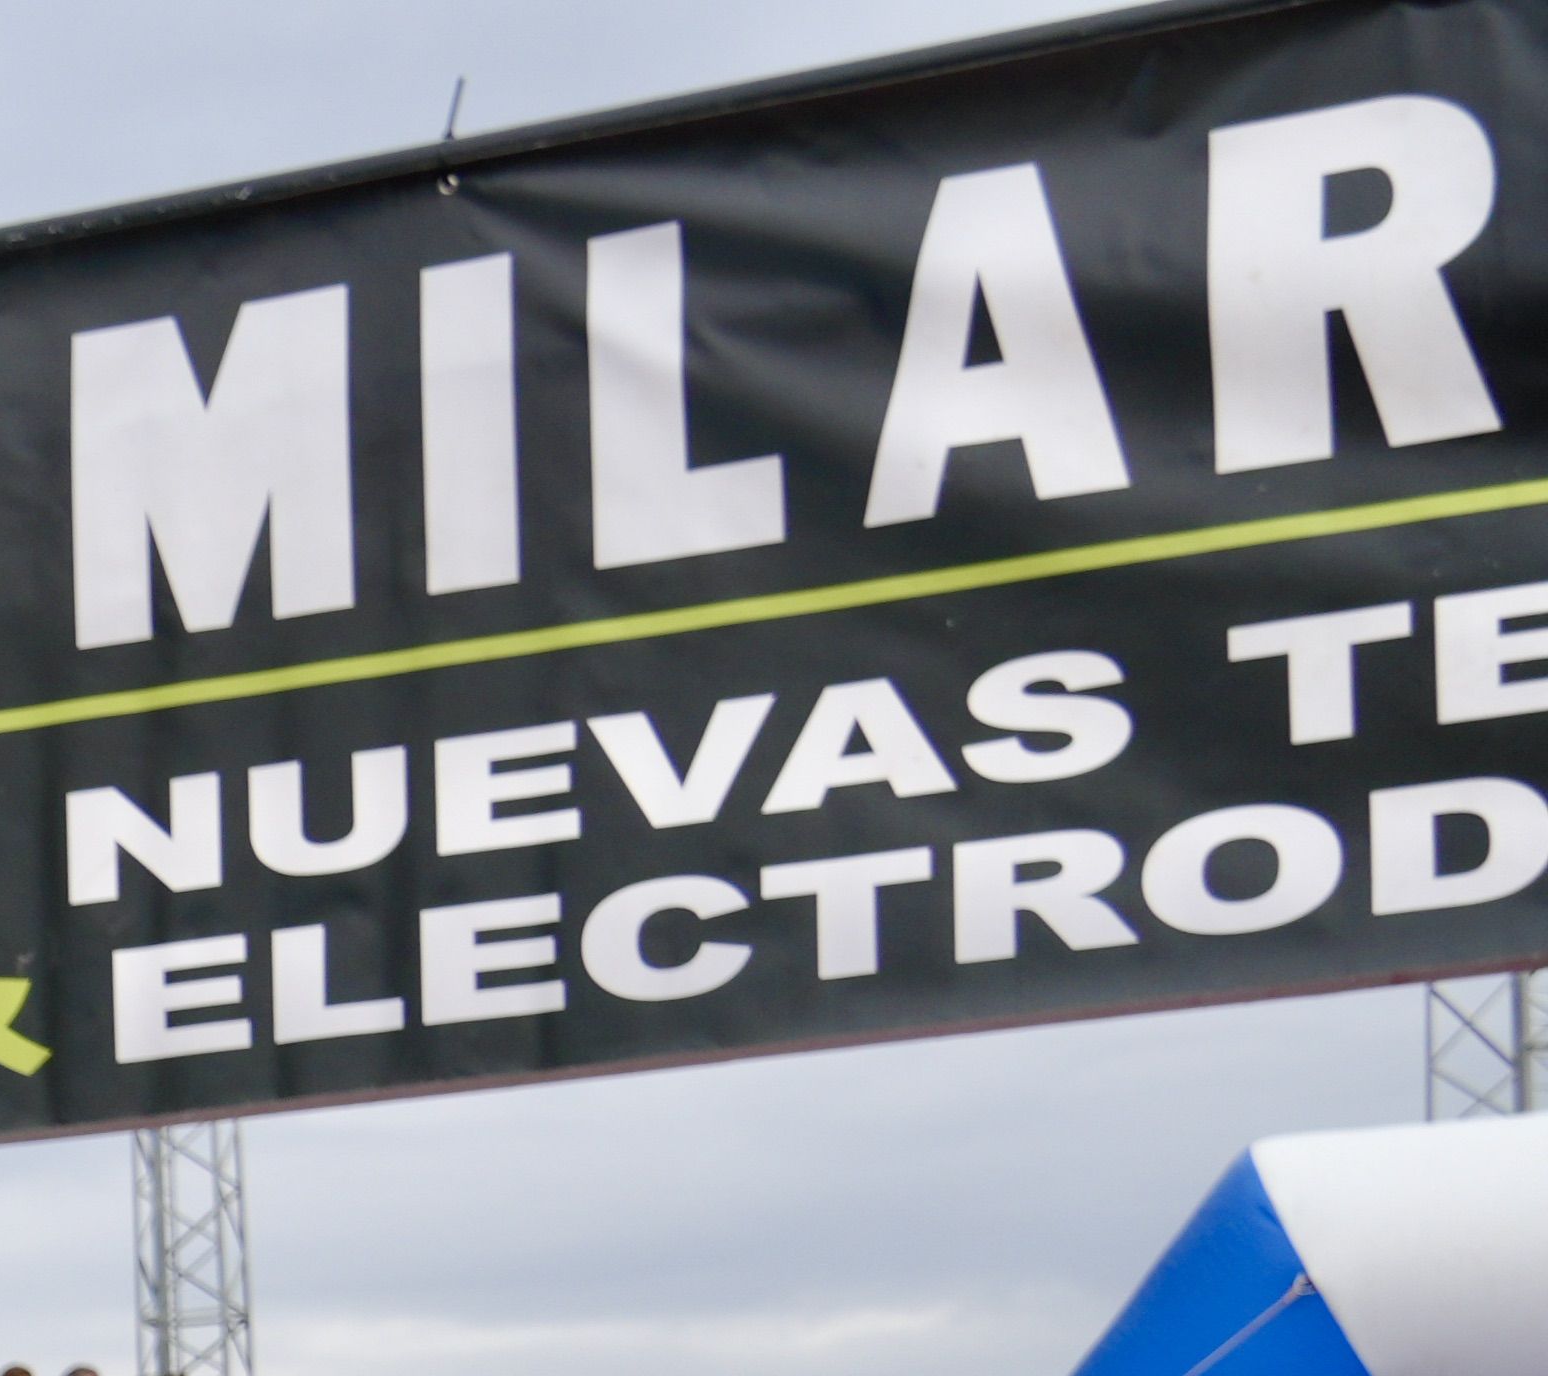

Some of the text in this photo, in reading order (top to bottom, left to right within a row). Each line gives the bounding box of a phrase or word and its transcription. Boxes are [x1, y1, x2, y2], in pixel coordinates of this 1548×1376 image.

[70, 93, 1501, 650] MILAR
[66, 650, 1132, 906] NUEVAS
[112, 775, 1548, 1064] ELECTROD
